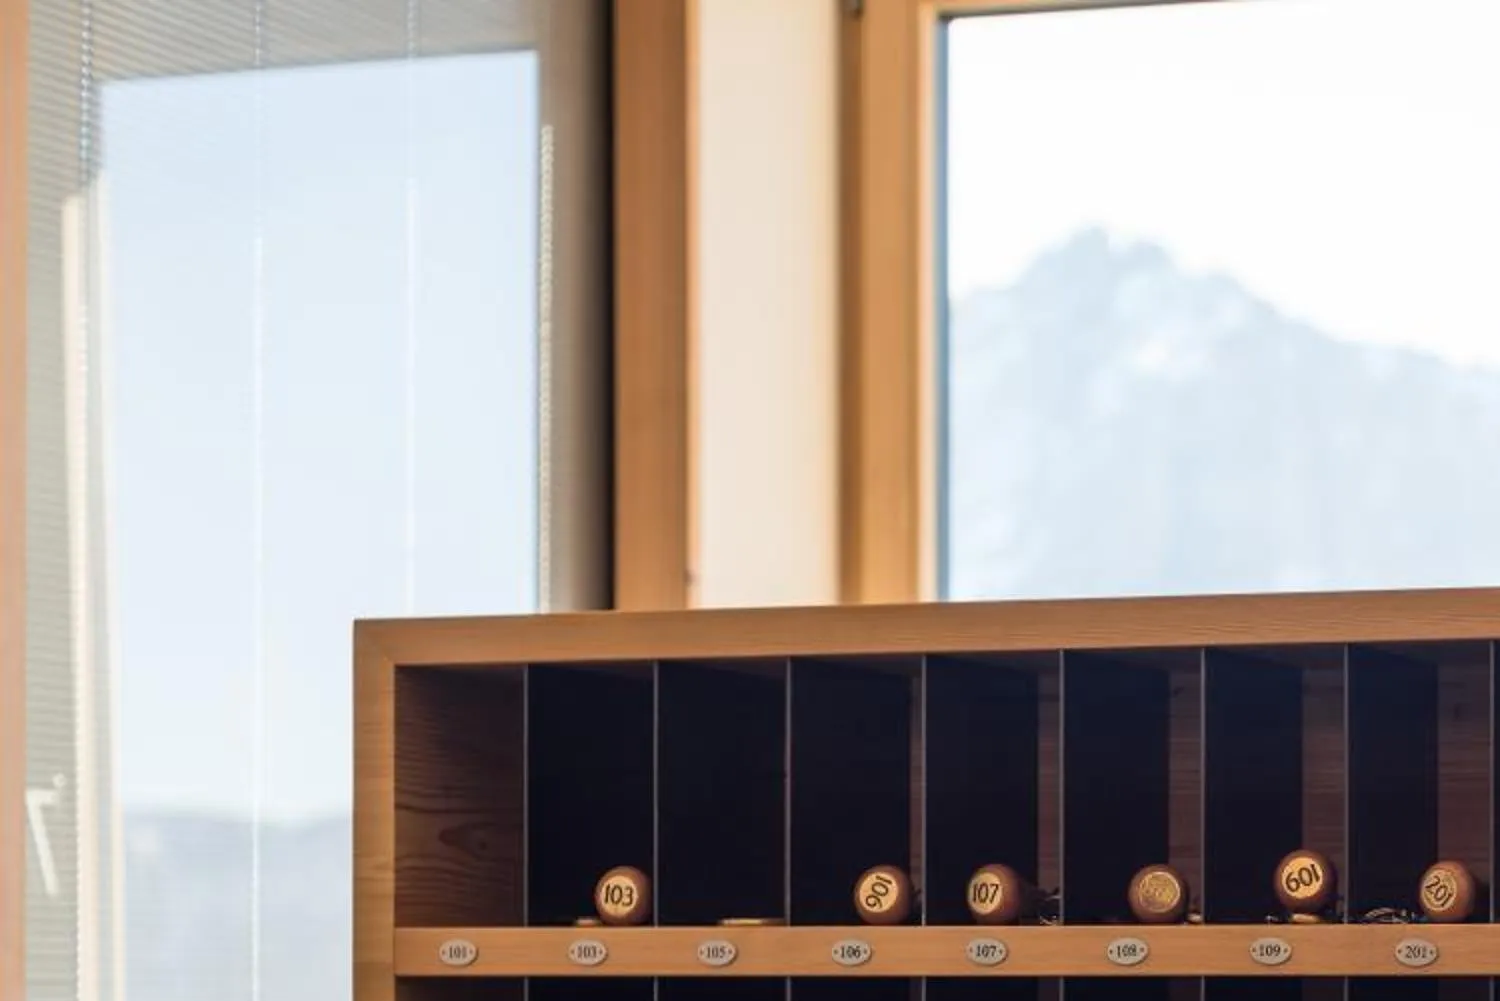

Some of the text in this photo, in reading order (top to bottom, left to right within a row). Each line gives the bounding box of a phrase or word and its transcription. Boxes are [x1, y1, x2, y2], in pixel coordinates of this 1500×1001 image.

[604, 883, 634, 907] 103
[972, 882, 999, 904] 107
[1425, 875, 1453, 908] 201
[577, 946, 597, 959] 103
[707, 945, 726, 958] 105
[841, 945, 862, 958] 106
[976, 945, 997, 958] 107
[1260, 944, 1281, 957] 109
[1405, 945, 1427, 958] 201
